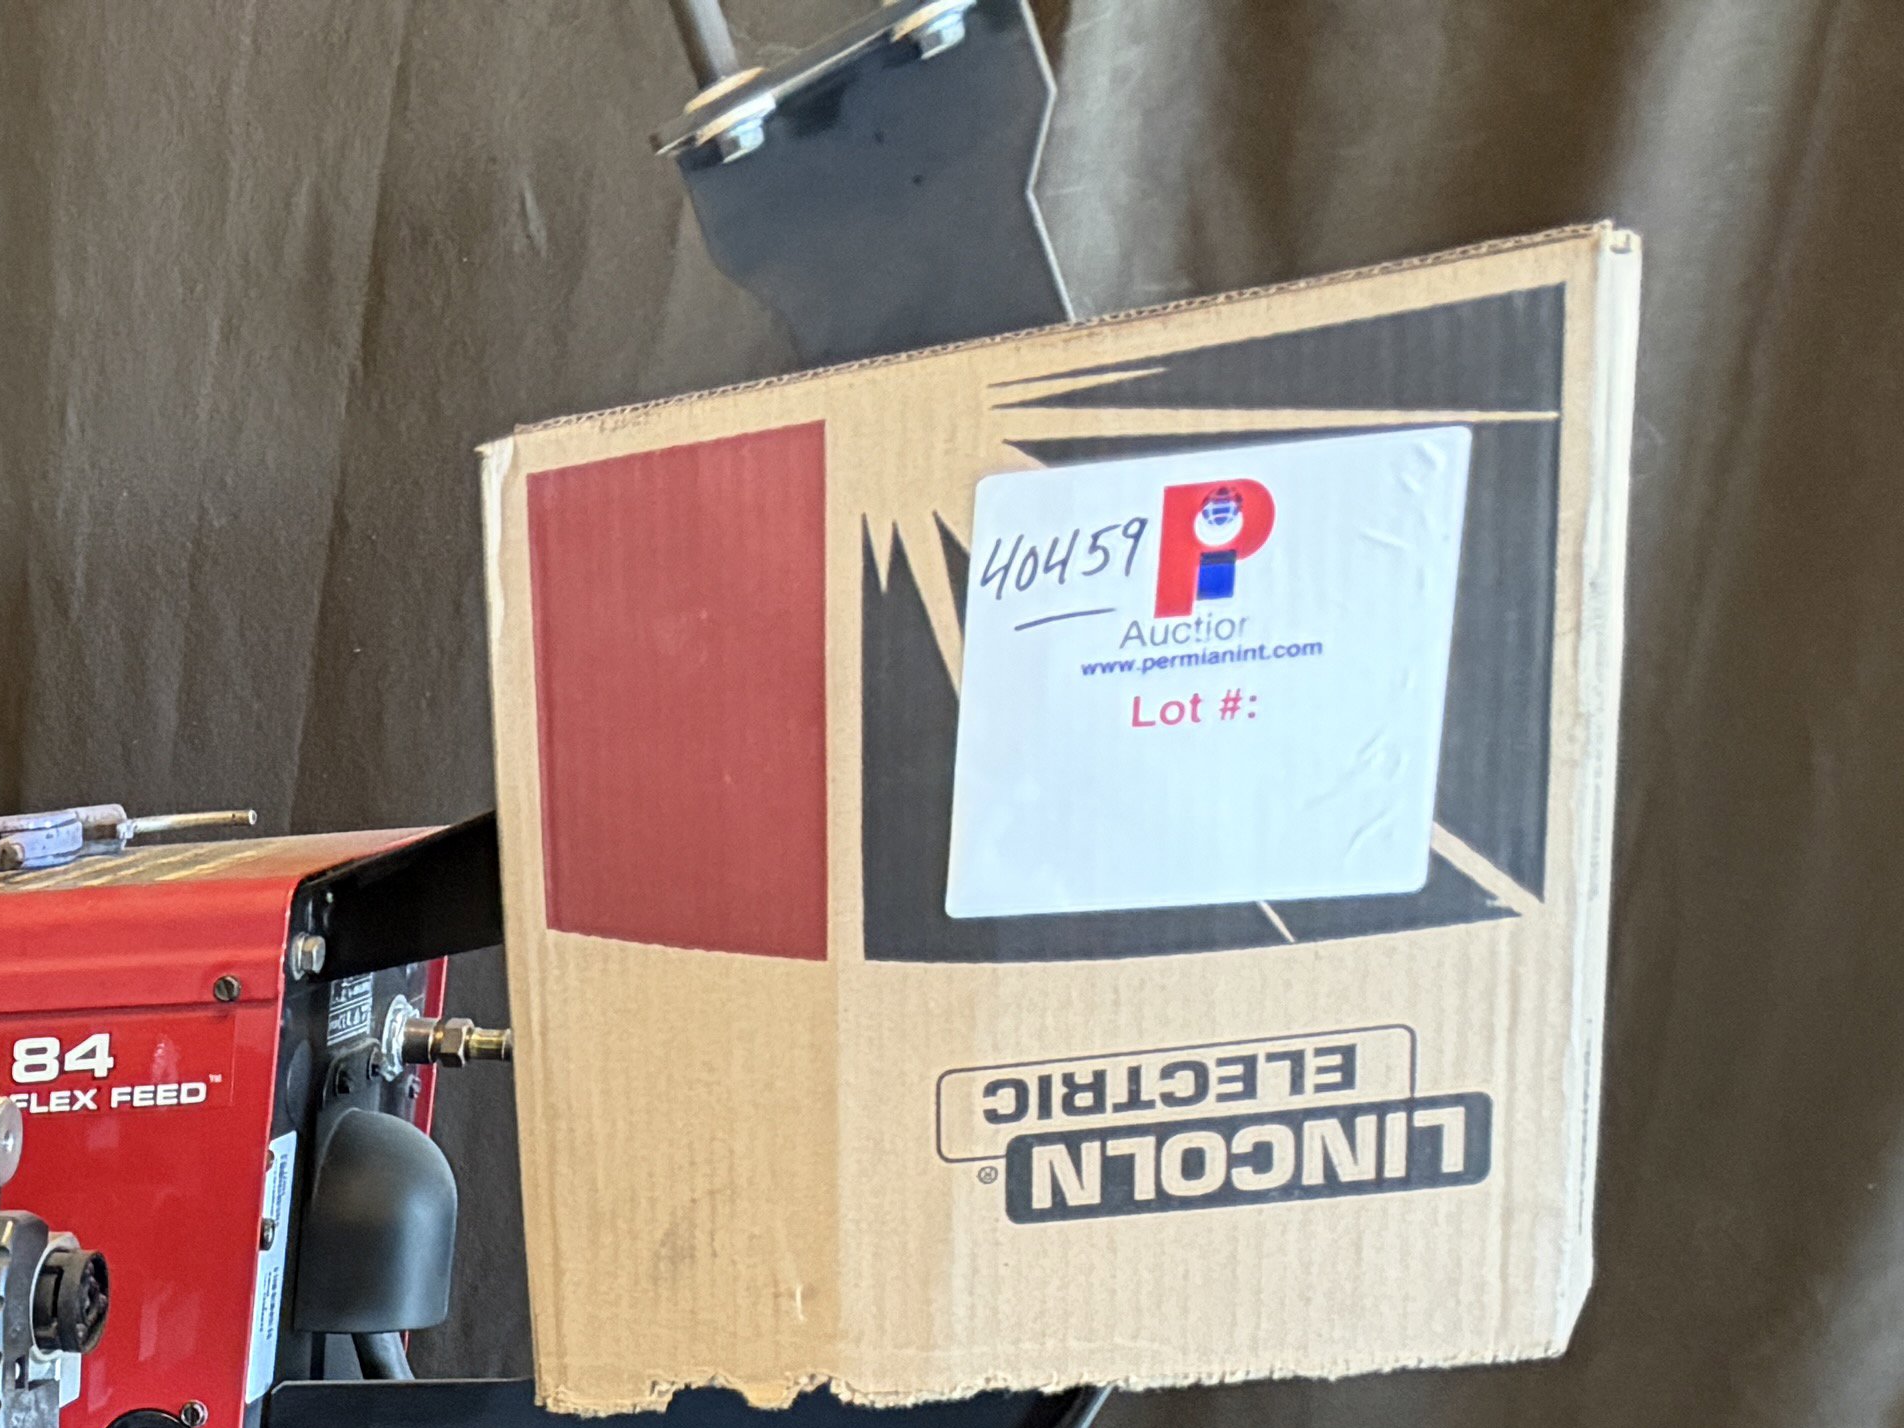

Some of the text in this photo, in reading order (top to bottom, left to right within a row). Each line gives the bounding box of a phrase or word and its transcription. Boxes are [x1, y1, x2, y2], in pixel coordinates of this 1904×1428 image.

[979, 516, 1149, 600] 40459
[1081, 638, 1323, 677] www.permianint.com
[1131, 692, 1202, 728] Lot
[11, 1033, 115, 1084] 84
[982, 1043, 1357, 1125] ELECTRIC
[9, 1082, 207, 1114] FLEX FEED
[1030, 1105, 1466, 1210] LINCOLN
